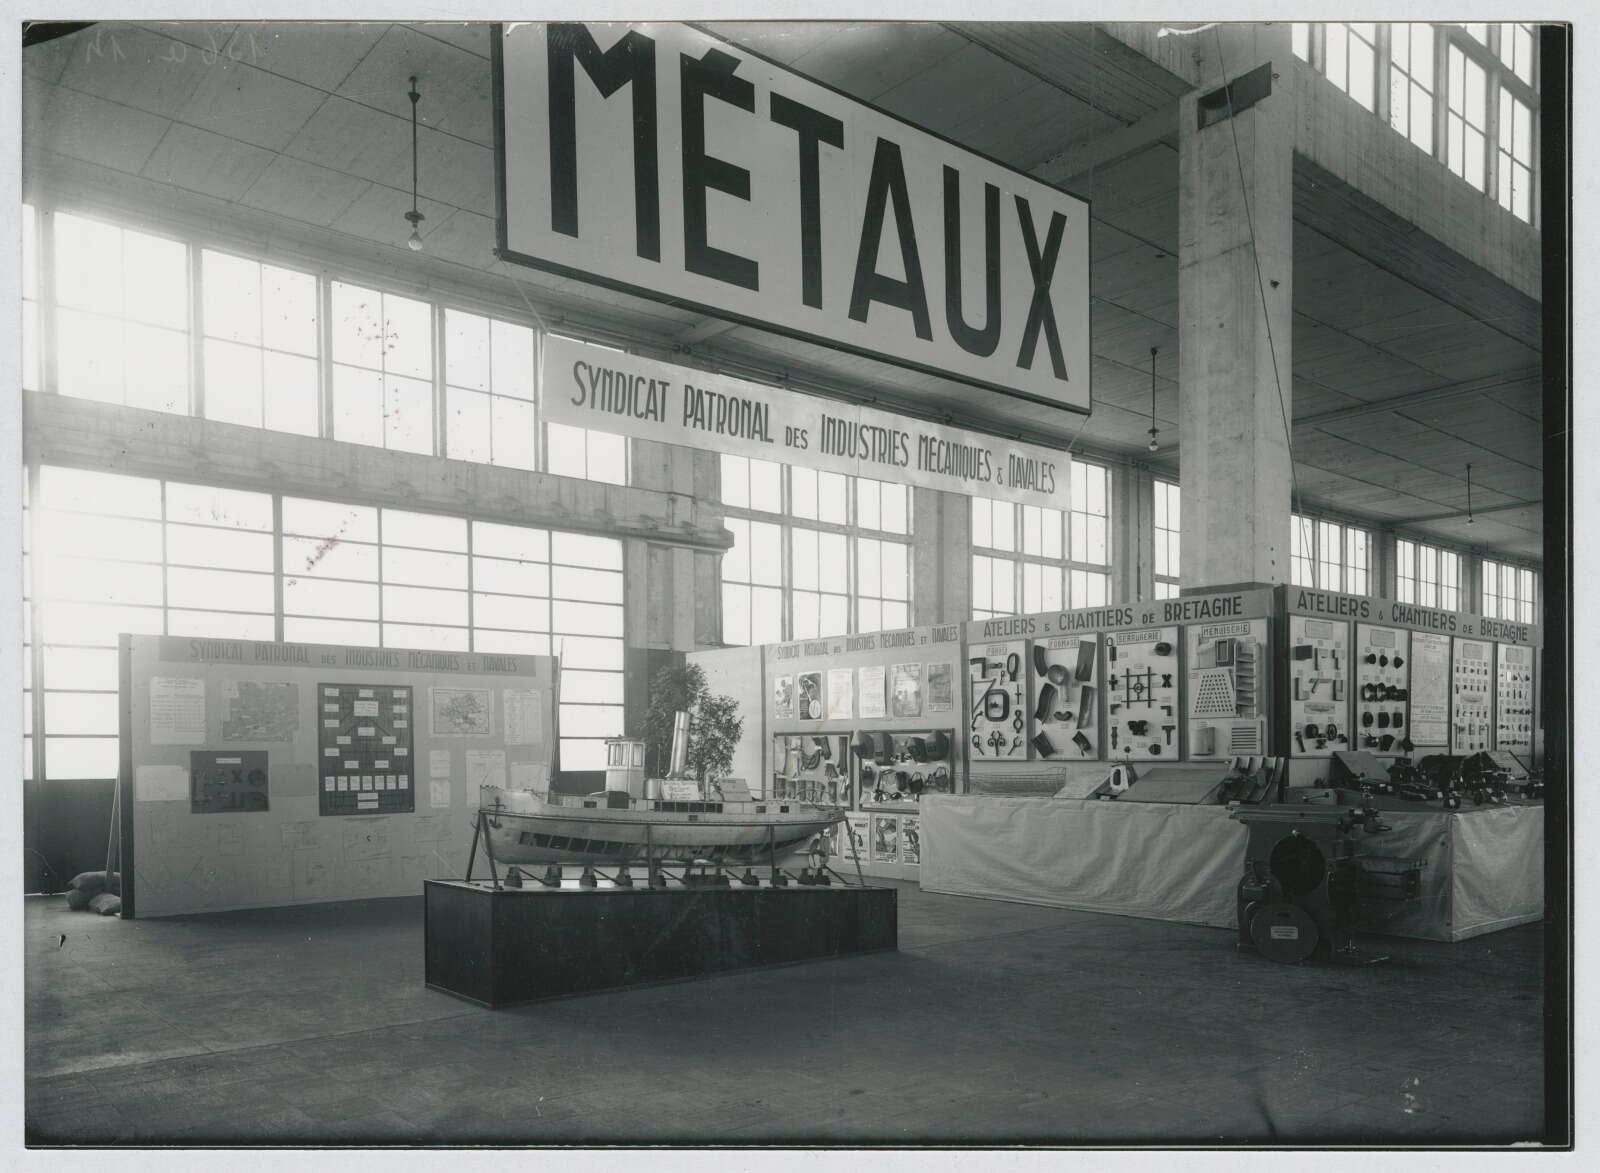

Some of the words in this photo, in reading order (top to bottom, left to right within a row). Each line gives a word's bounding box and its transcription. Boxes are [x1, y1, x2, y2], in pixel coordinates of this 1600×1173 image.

[547, 23, 1068, 382] MÉTAUX
[571, 361, 670, 423] SYNDICAT
[683, 384, 774, 444] PATRONAL
[785, 425, 809, 450] DES
[820, 413, 910, 468] INDUSTRIES
[918, 434, 992, 482] MÉCANIQUES
[1008, 453, 1056, 495] NAVALES
[983, 617, 1036, 638] ATELIERS
[1059, 607, 1134, 631] CHANTIERS
[1142, 613, 1156, 625] DE
[1164, 596, 1243, 622] BRETAGNE
[1204, 623, 1248, 636] MENUISERIE
[1297, 590, 1370, 619] ATELIERS
[1392, 603, 1457, 632] CHANTIERS
[1463, 624, 1473, 634] DE
[1480, 618, 1529, 642] BRETAGNE
[190, 639, 243, 661] SYNDICAT
[255, 643, 310, 664] PATRONAL
[345, 647, 400, 668] INDUSTRIES
[483, 655, 518, 672] NAVALES
[920, 636, 928, 645] ET
